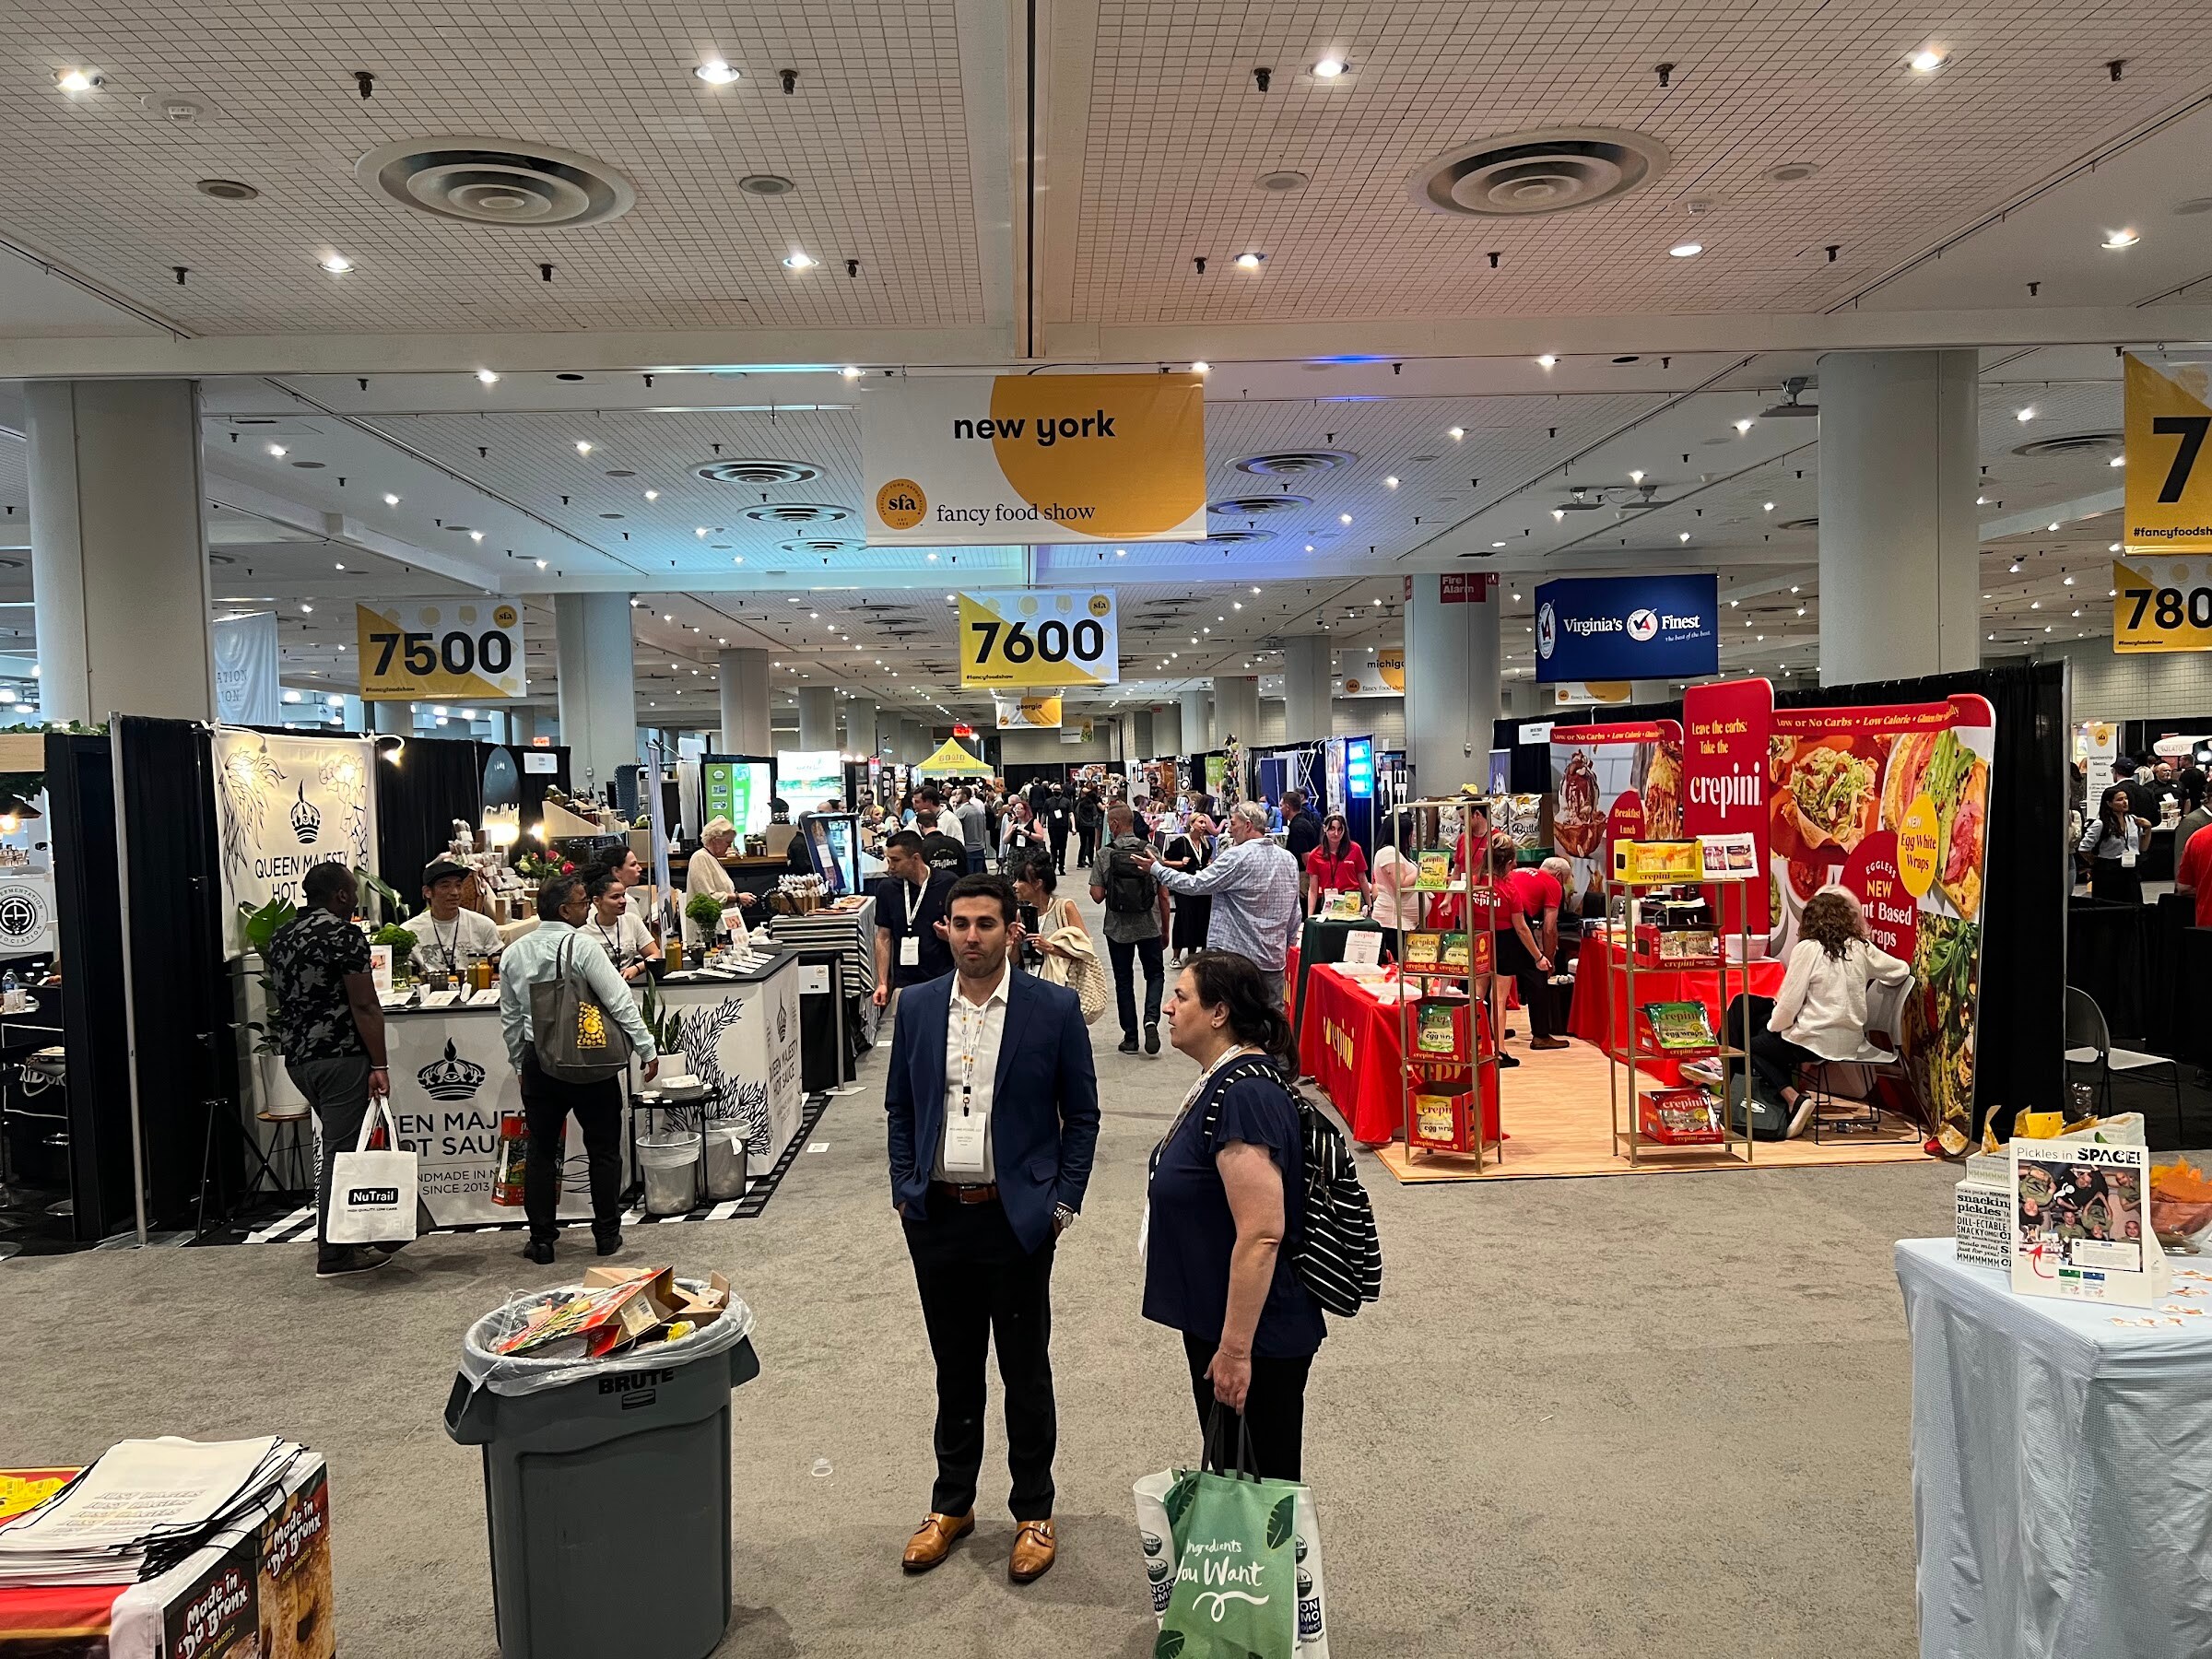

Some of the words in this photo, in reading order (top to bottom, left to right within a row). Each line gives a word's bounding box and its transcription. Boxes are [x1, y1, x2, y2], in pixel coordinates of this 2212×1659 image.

[954, 418, 1025, 440] new
[1036, 409, 1116, 447] york
[888, 494, 917, 511] sfa
[936, 504, 991, 526] fancy
[995, 504, 1039, 522] food
[1043, 503, 1095, 521] show
[1442, 576, 1463, 585] Fire
[1443, 585, 1475, 594] Alarm
[1093, 600, 1107, 609] sfa
[499, 612, 513, 620] sfa
[1563, 617, 1623, 636] Virginia's
[1662, 614, 1700, 629] Finest
[971, 619, 1104, 664] 7600
[370, 630, 512, 676] 7500
[1692, 722, 1710, 735] Leave
[1712, 720, 1724, 734] the
[1777, 718, 1793, 726] Low
[1808, 718, 1821, 727] No
[1824, 717, 1853, 726] Carbs
[1863, 717, 1883, 725] Low
[1883, 714, 1911, 724] Calorie
[1700, 740, 1715, 754] Take
[1717, 739, 1729, 754] the
[1689, 761, 1760, 818] crepini
[1614, 808, 1641, 819] Breakfast
[1619, 825, 1636, 834] Lunch
[1907, 818, 1922, 830] NEW
[1901, 833, 1914, 851] Egg
[1916, 833, 1936, 850] White
[255, 856, 300, 878] QUEEN
[1865, 861, 1897, 878] EGGLESS
[1907, 854, 1929, 872] Wraps
[1640, 872, 1671, 881] crepini
[272, 882, 297, 900] HOT
[1866, 880, 1892, 899] NEW
[1878, 903, 1912, 926] Based
[1868, 924, 1897, 947] raps
[1665, 959, 1695, 968] crepini
[1659, 1011, 1699, 1022] crepini
[1663, 1097, 1703, 1110] crepini
[393, 1113, 434, 1135] EN
[442, 1135, 503, 1156] SAU
[2017, 1147, 2058, 1159] Pickles
[2063, 1151, 2073, 1159] in
[2077, 1148, 2141, 1165] SPACE!
[474, 1170, 486, 1180] IN
[353, 1191, 394, 1202] NuTrail
[422, 1183, 460, 1195] SINCE
[463, 1182, 490, 1193] 2013
[1958, 1204, 2002, 1217] pickles
[1957, 1217, 2006, 1231] DILL-ECTABLE
[1957, 1226, 1984, 1237] SNACKY
[599, 1370, 675, 1394] BRUTE
[274, 1511, 302, 1551] Made
[303, 1500, 313, 1518] in
[289, 1512, 322, 1557] Bronx
[1186, 1538, 1242, 1557] Ingredients
[1204, 1557, 1265, 1586] Want
[187, 1585, 223, 1632] Made
[226, 1573, 238, 1594] in
[207, 1585, 248, 1637] Bronx
[213, 1624, 235, 1653] BAGELS
